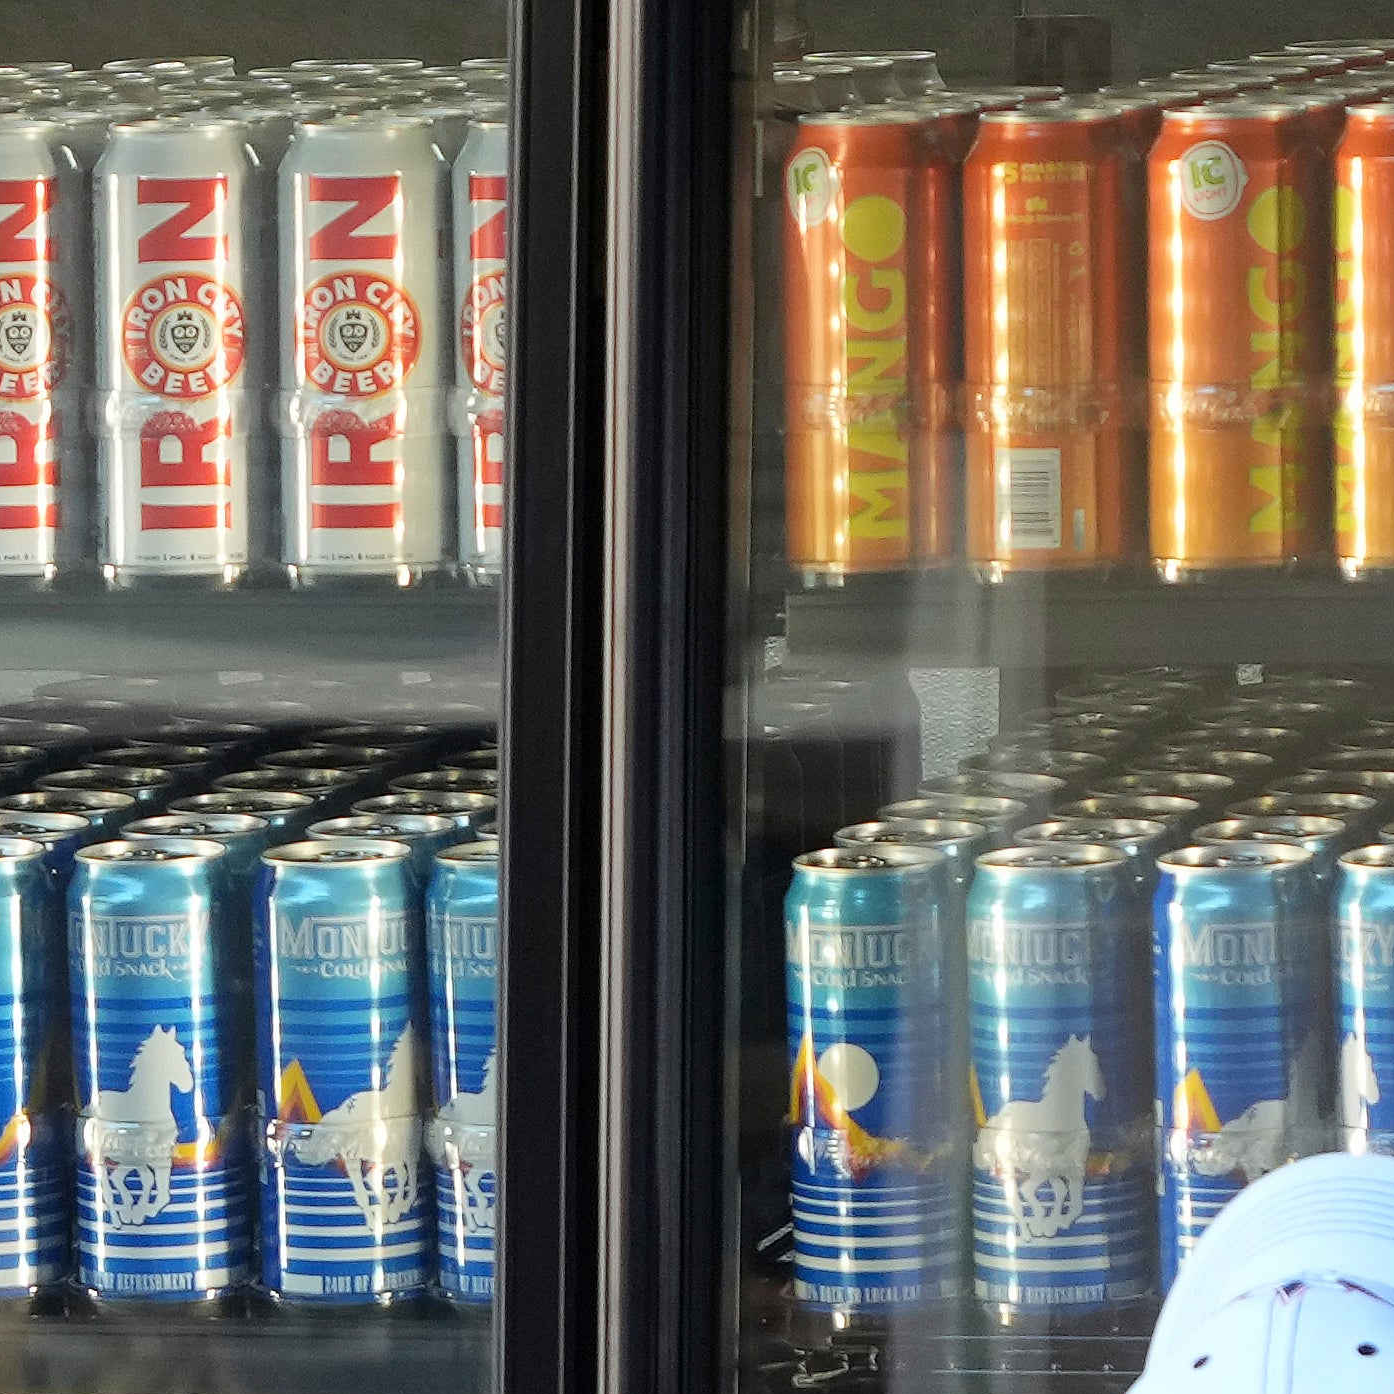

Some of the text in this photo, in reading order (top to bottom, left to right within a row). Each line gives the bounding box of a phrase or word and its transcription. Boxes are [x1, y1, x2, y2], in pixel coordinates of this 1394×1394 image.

[1189, 156, 1226, 189] IC
[126, 277, 189, 340] IRON
[296, 277, 417, 340] IRON CITY
[311, 358, 397, 394] BEER
